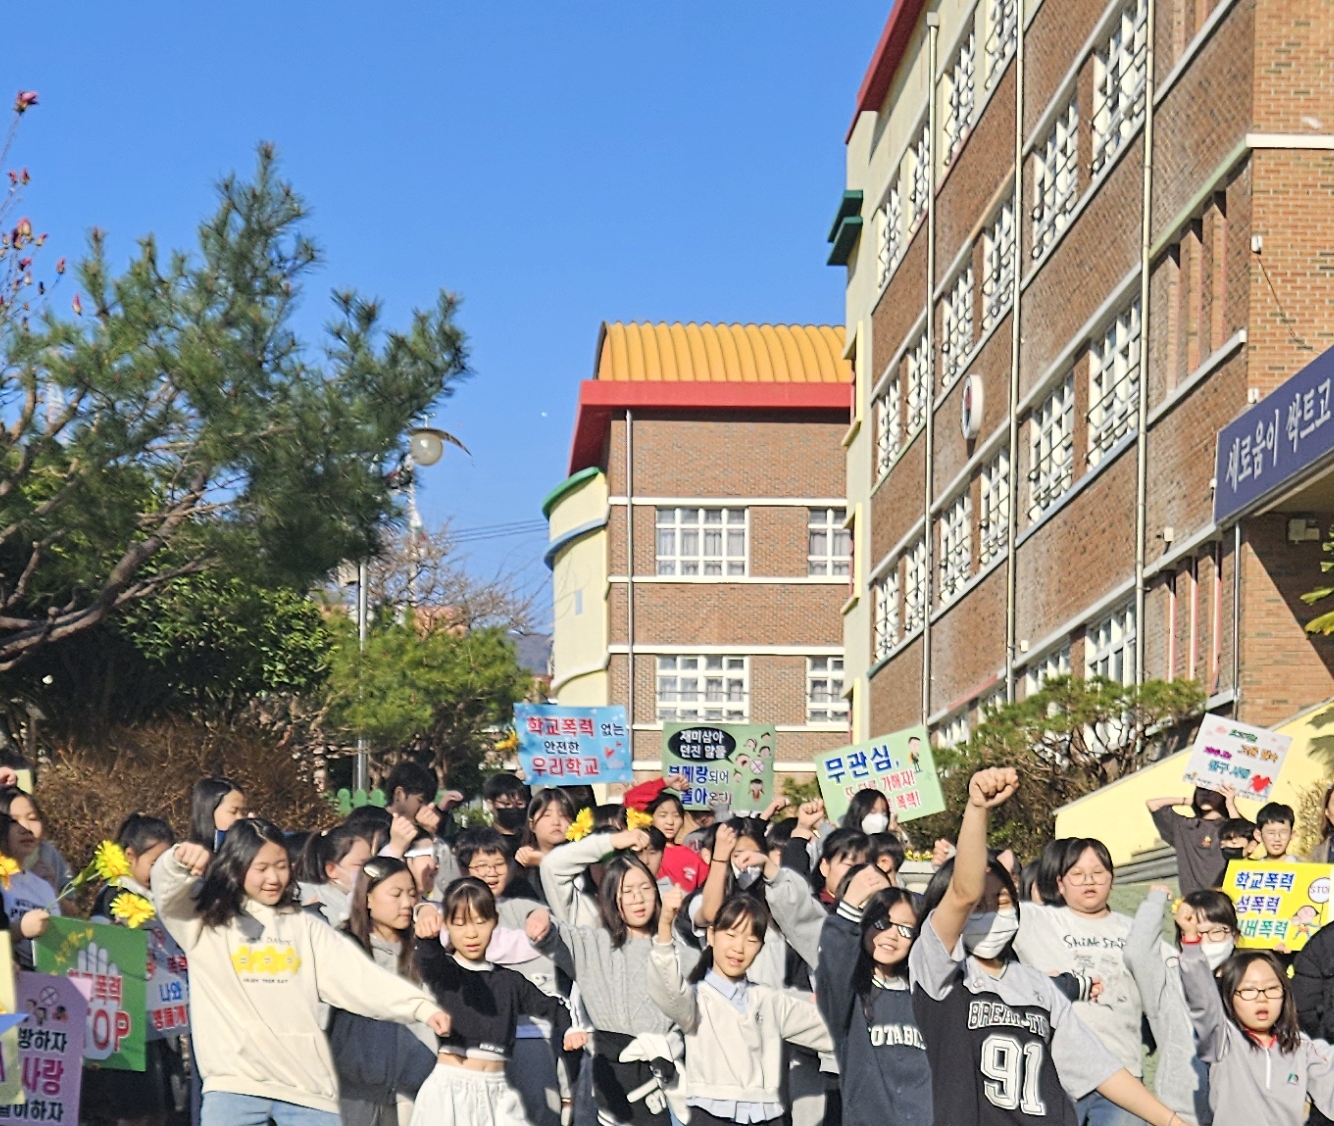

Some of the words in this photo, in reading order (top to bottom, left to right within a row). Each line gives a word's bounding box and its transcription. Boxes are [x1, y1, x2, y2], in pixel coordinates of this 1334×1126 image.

[1225, 408, 1280, 494] 새로움이
[1285, 377, 1332, 454] 싹트고
[527, 715, 595, 737] 학교폭력
[600, 722, 625, 737] 없는
[543, 740, 580, 755] 안전한
[679, 730, 725, 745] 재미삼아
[531, 757, 599, 777] 우리학교
[824, 744, 901, 783] 무관심,
[1234, 871, 1295, 891] 학교폭력
[1310, 884, 1331, 897] STO
[1235, 896, 1280, 915] 성폭력
[980, 1032, 1047, 1116] 91
